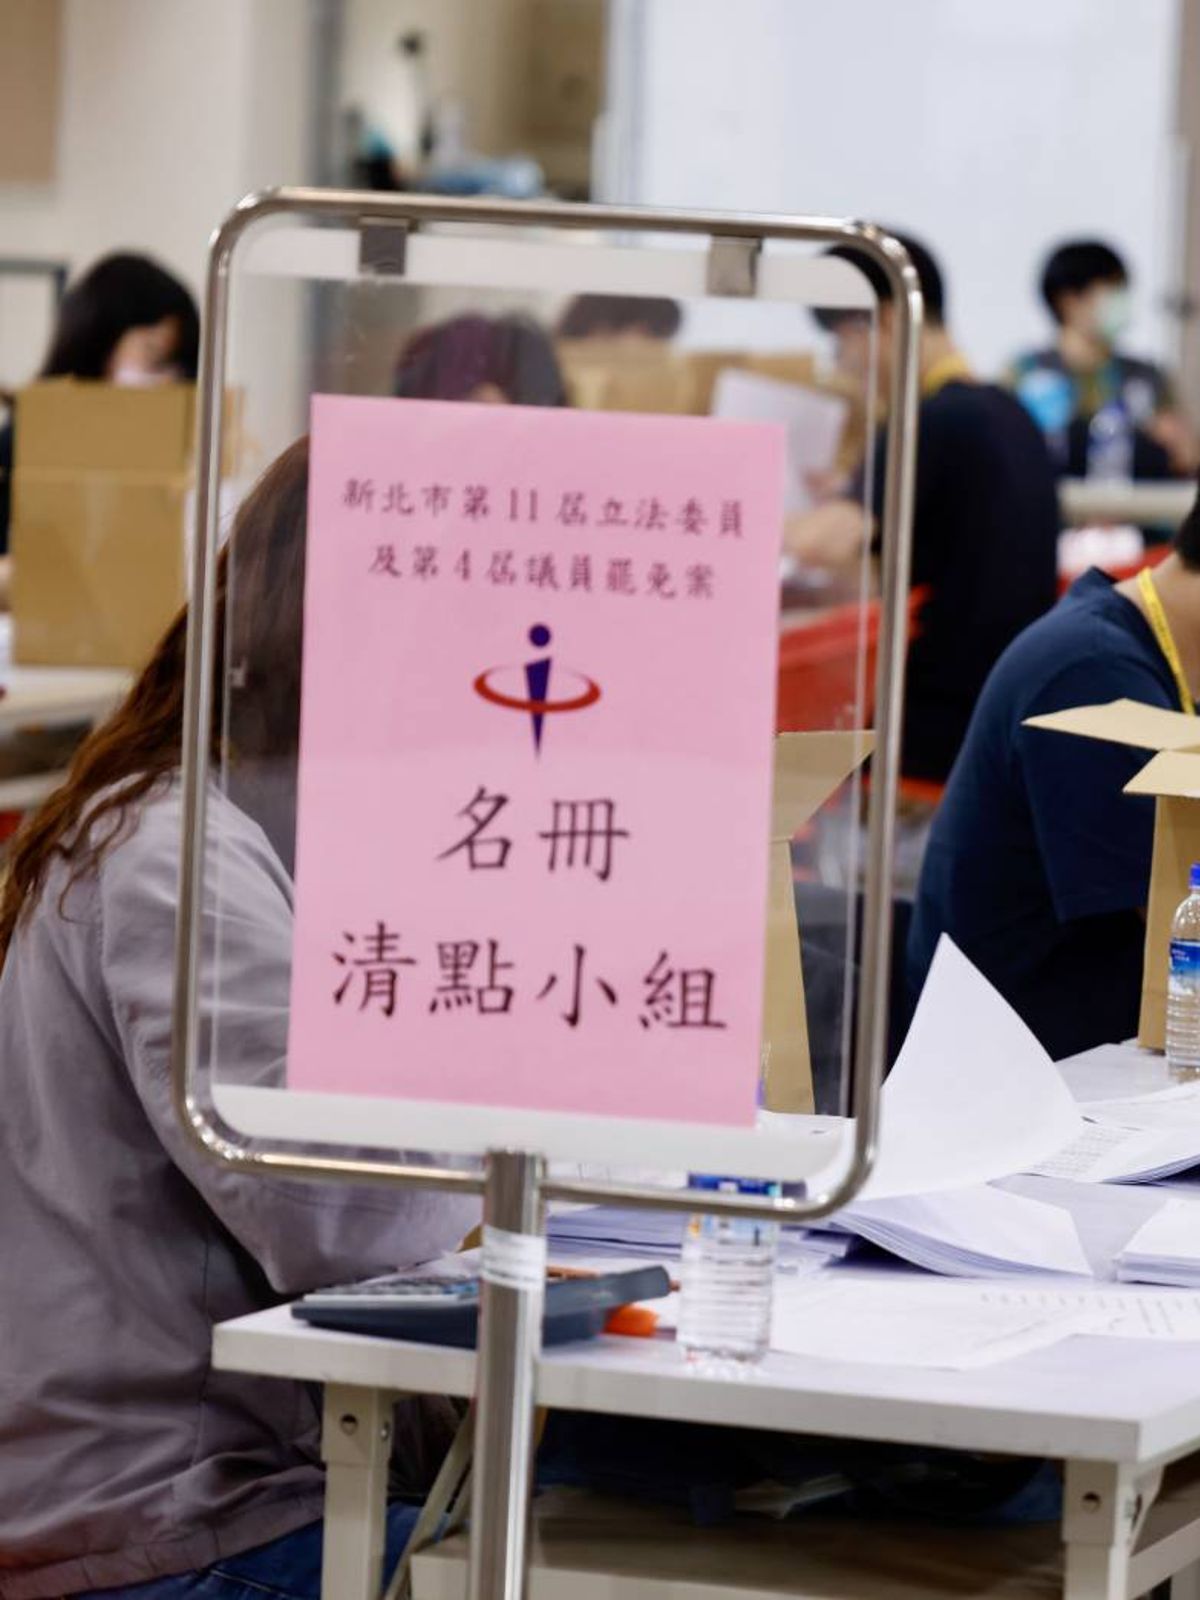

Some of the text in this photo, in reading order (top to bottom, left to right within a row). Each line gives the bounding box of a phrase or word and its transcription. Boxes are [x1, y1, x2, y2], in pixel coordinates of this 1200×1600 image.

[436, 785, 631, 883] 名冊
[331, 920, 728, 1032] 清點小組
